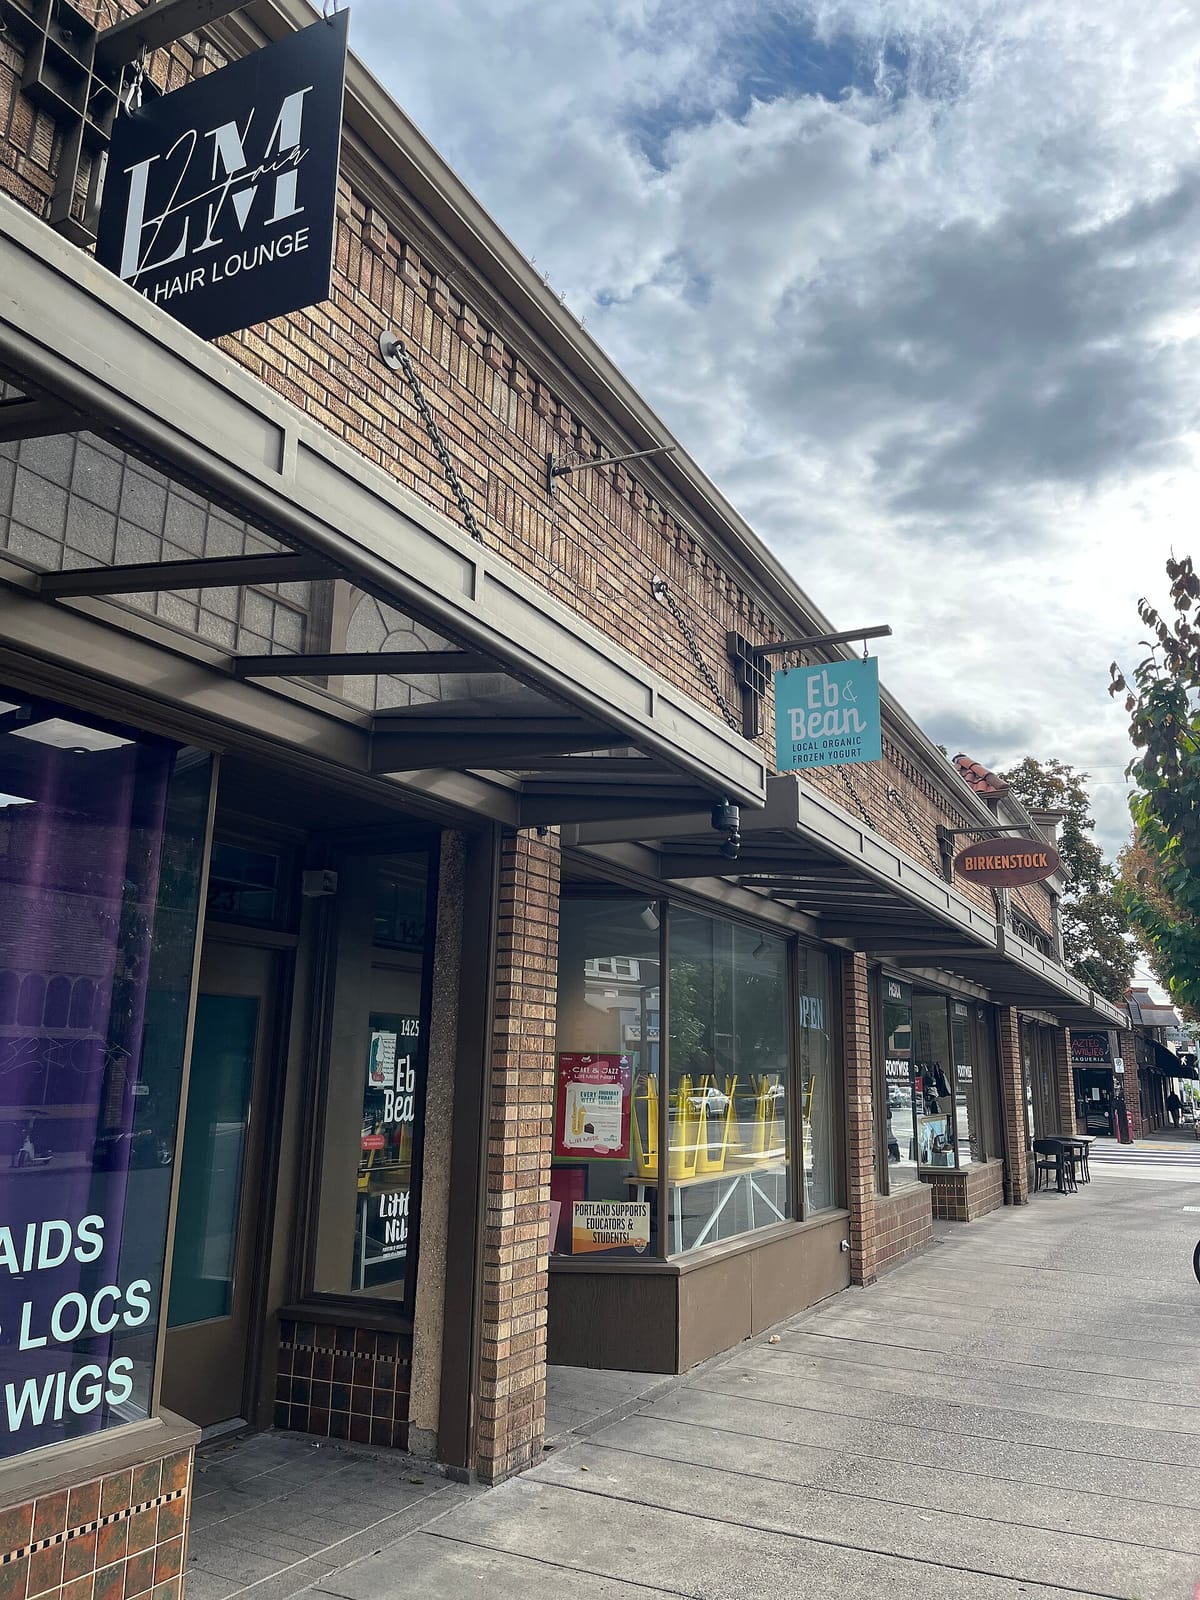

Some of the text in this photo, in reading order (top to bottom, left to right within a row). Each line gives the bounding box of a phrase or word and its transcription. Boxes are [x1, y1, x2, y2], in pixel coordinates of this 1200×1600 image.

[154, 227, 310, 303] HAIR LOUNGE
[807, 669, 858, 710] Eb &
[787, 707, 868, 741] Bean
[792, 736, 862, 753] LOCAL ORGANIC
[792, 748, 862, 764] FROZEN YOGURT
[965, 853, 1048, 871] BIRKENSTOCK
[400, 1019, 420, 1037] 1425
[1072, 1039, 1100, 1049] AZTEC
[1073, 1047, 1105, 1057] WILLIES
[396, 1054, 415, 1092] Eb
[601, 1067, 619, 1075] JAZZ
[885, 1059, 910, 1077] FOOTWISE
[383, 1089, 415, 1123] Bea
[575, 1204, 647, 1217] PORTLAND SUPPORTS
[586, 1217, 634, 1231] EDUCATORS &
[592, 1231, 630, 1244] STUDENTS!
[19, 1279, 151, 1351] LOCS
[5, 1356, 134, 1433] WIGS
